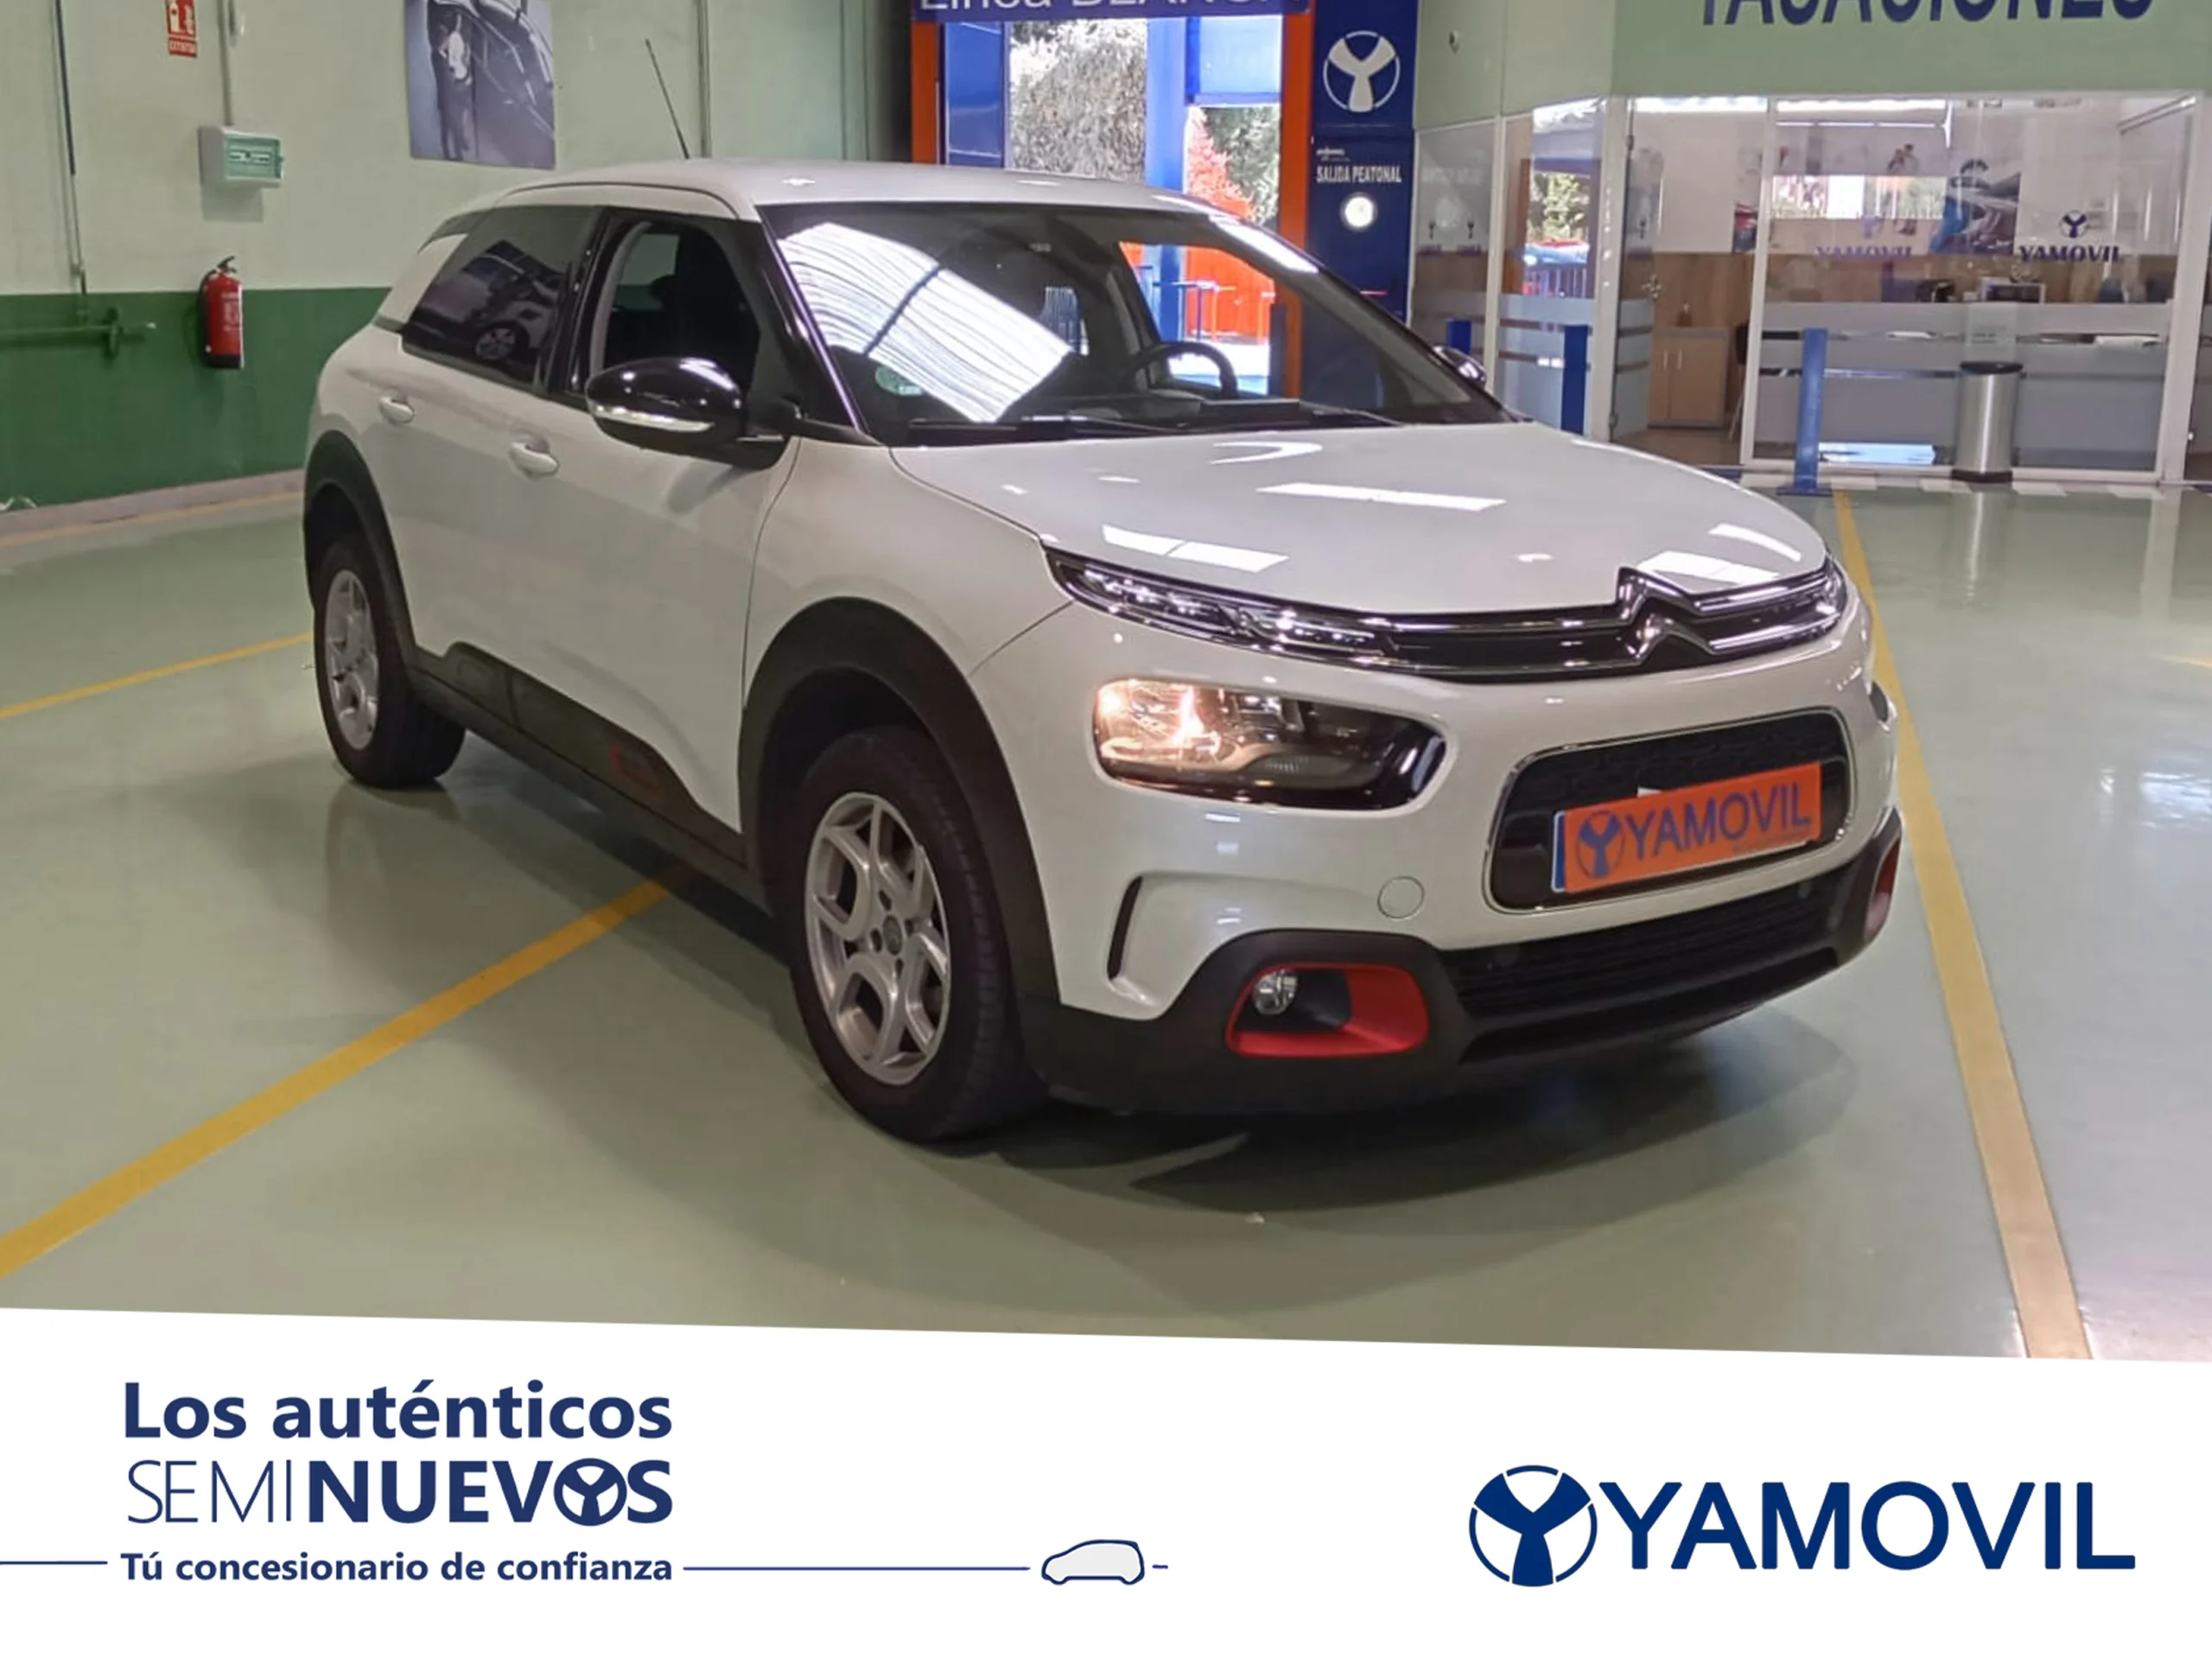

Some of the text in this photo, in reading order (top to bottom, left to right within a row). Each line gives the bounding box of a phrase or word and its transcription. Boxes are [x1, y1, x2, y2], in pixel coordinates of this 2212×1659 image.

[1316, 165, 1402, 183] SALIDA PEATONAL
[1624, 781, 1812, 861] YAMOVIL
